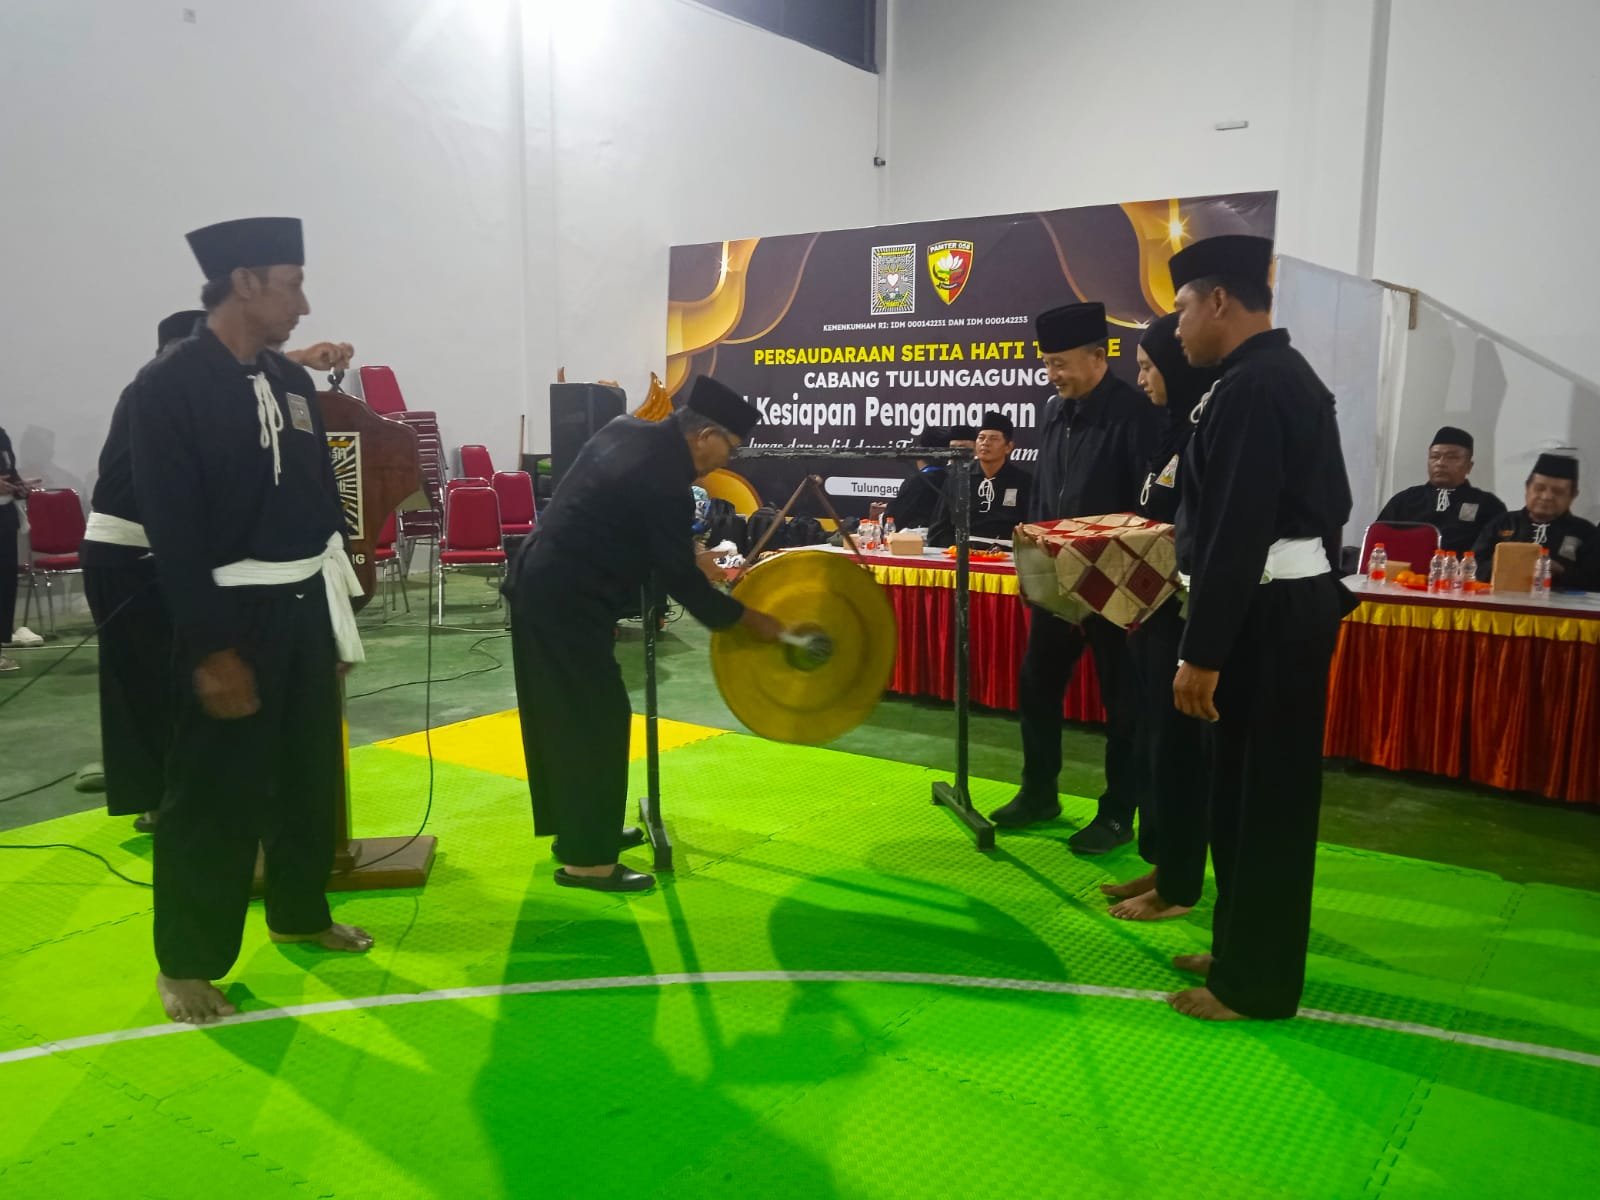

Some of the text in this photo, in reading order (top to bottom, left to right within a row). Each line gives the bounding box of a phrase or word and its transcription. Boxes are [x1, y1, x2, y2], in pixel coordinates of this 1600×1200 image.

[823, 322, 877, 332] KEMENKUMHAM
[878, 321, 889, 330] RI:
[890, 320, 906, 330] IDM
[948, 318, 965, 327] DAN
[966, 317, 983, 326] IDM
[754, 345, 895, 366] PERSAUDARAAN
[901, 343, 964, 362] SETIA
[970, 341, 1025, 360] HATI
[803, 367, 1049, 389] CABANG TULUNGAGUNG
[756, 392, 857, 434] Kesiapan
[850, 482, 899, 497] Tulungag
